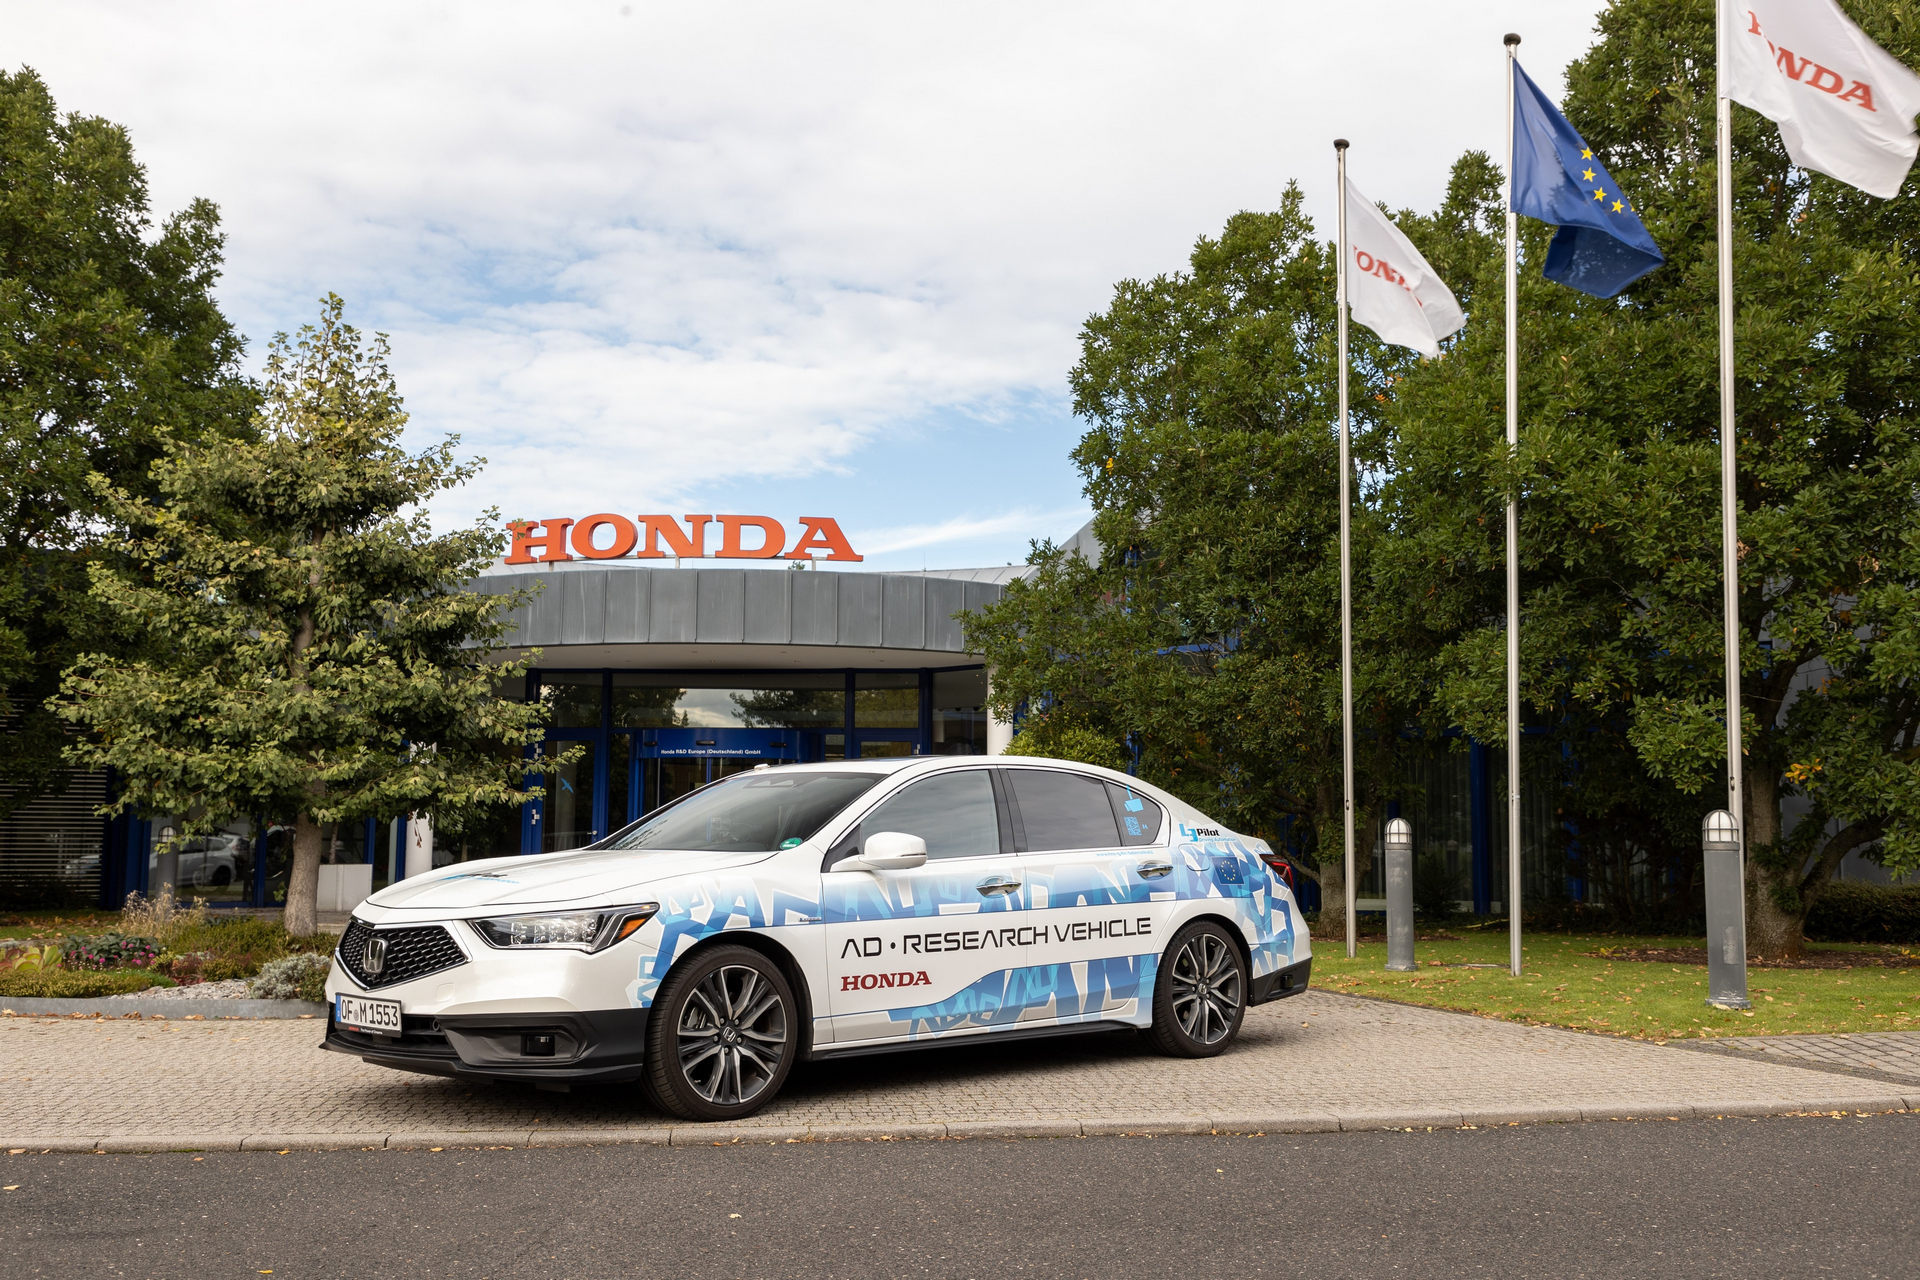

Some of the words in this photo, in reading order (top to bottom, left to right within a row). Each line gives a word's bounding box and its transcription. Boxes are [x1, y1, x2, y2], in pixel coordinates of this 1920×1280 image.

[1748, 11, 1877, 112] NDA
[504, 513, 864, 565] HONDA
[840, 936, 882, 959] AD
[903, 925, 1048, 955] RESEARCH
[1053, 917, 1151, 942] VEHICLE
[840, 970, 932, 992] HONDA
